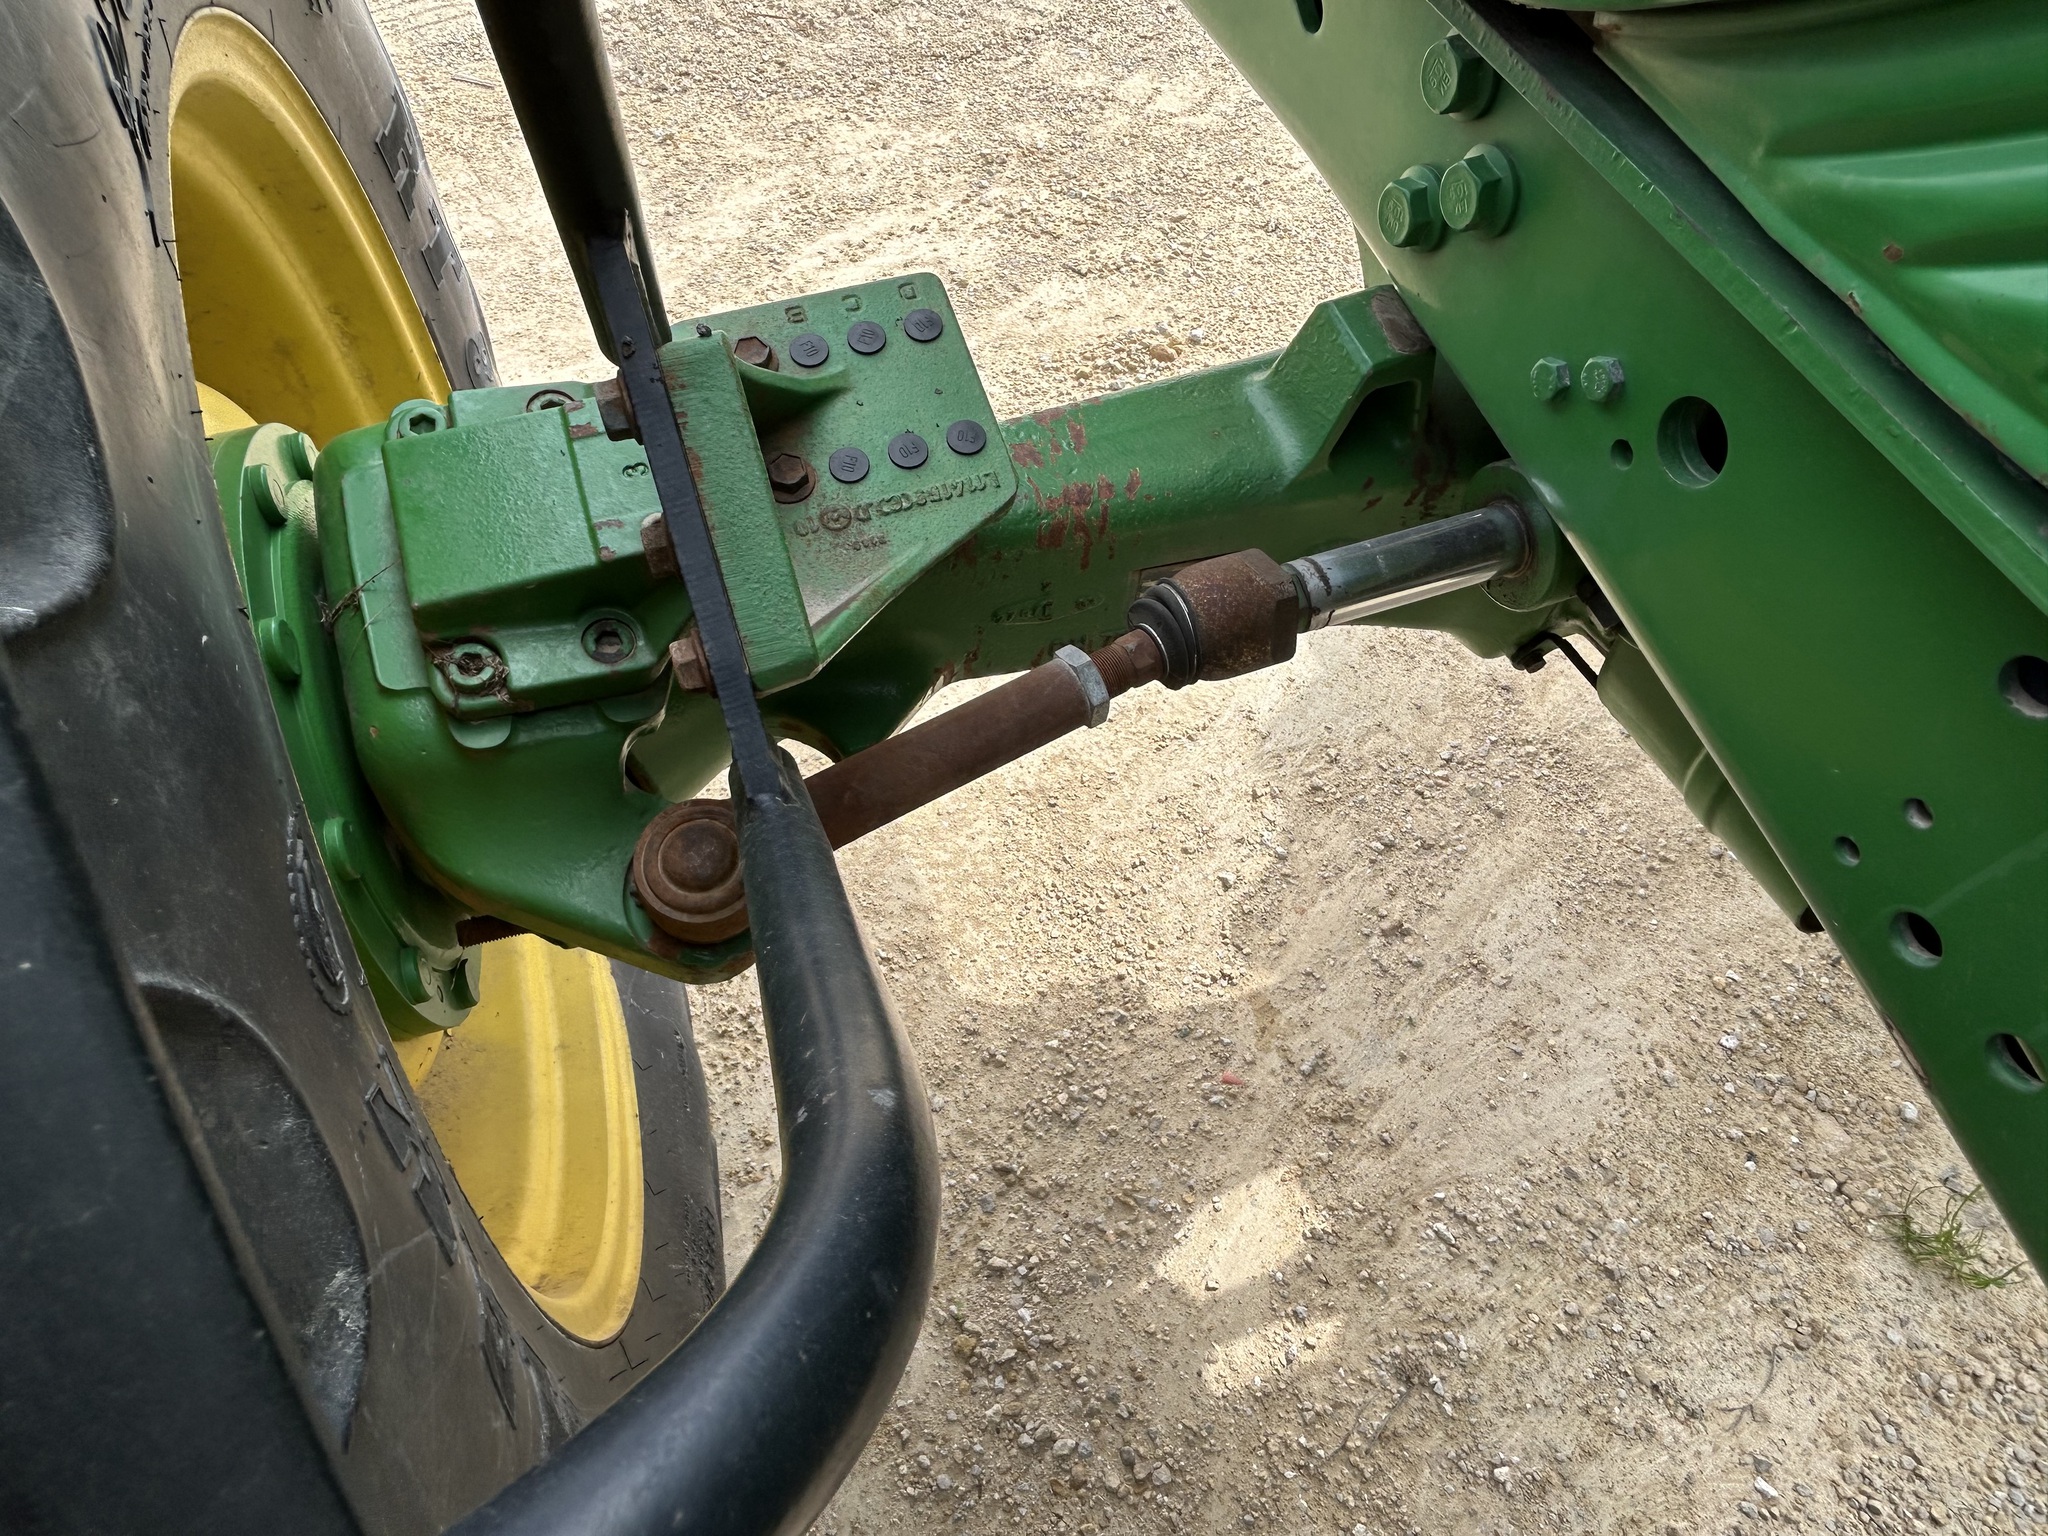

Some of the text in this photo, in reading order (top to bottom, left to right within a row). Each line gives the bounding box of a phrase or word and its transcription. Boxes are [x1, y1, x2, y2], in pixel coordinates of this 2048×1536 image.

[897, 282, 918, 301] D
[841, 293, 862, 312] C
[784, 304, 808, 324] B
[857, 328, 876, 347] F10
[800, 339, 820, 358] F10
[956, 429, 977, 445] F10
[898, 442, 920, 460] F10
[841, 454, 859, 474] F10
